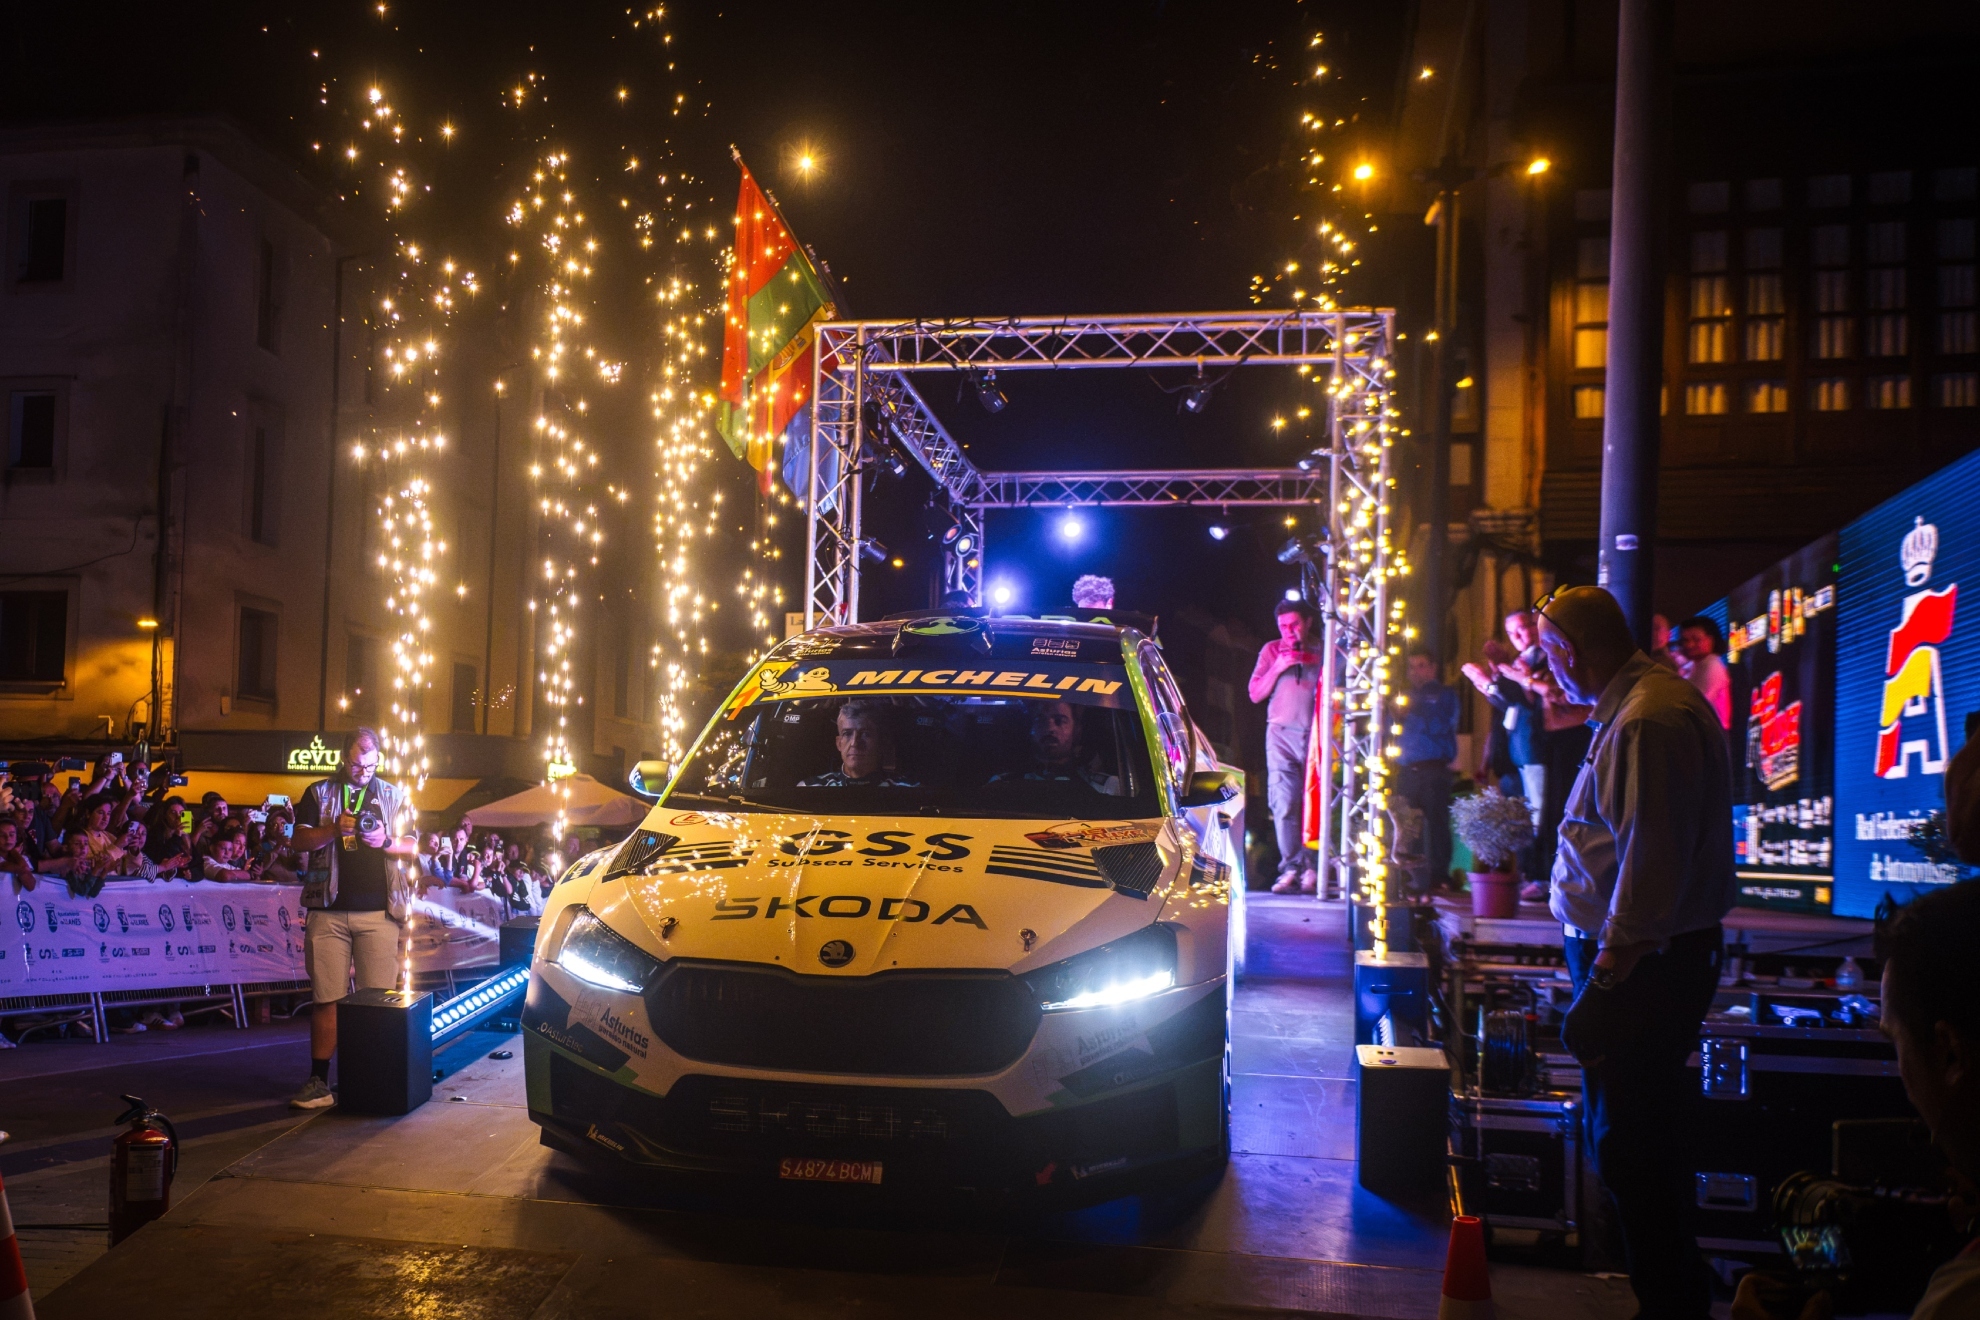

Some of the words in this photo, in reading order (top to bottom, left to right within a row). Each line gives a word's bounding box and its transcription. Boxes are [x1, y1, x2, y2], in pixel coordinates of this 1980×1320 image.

[846, 670, 1123, 695] MICHELIN
[784, 714, 800, 722] OMP
[778, 829, 975, 861] GSS
[767, 858, 854, 868] Subsea
[862, 858, 964, 873] Services
[600, 1007, 649, 1049] Asturias
[622, 1040, 647, 1059] natural
